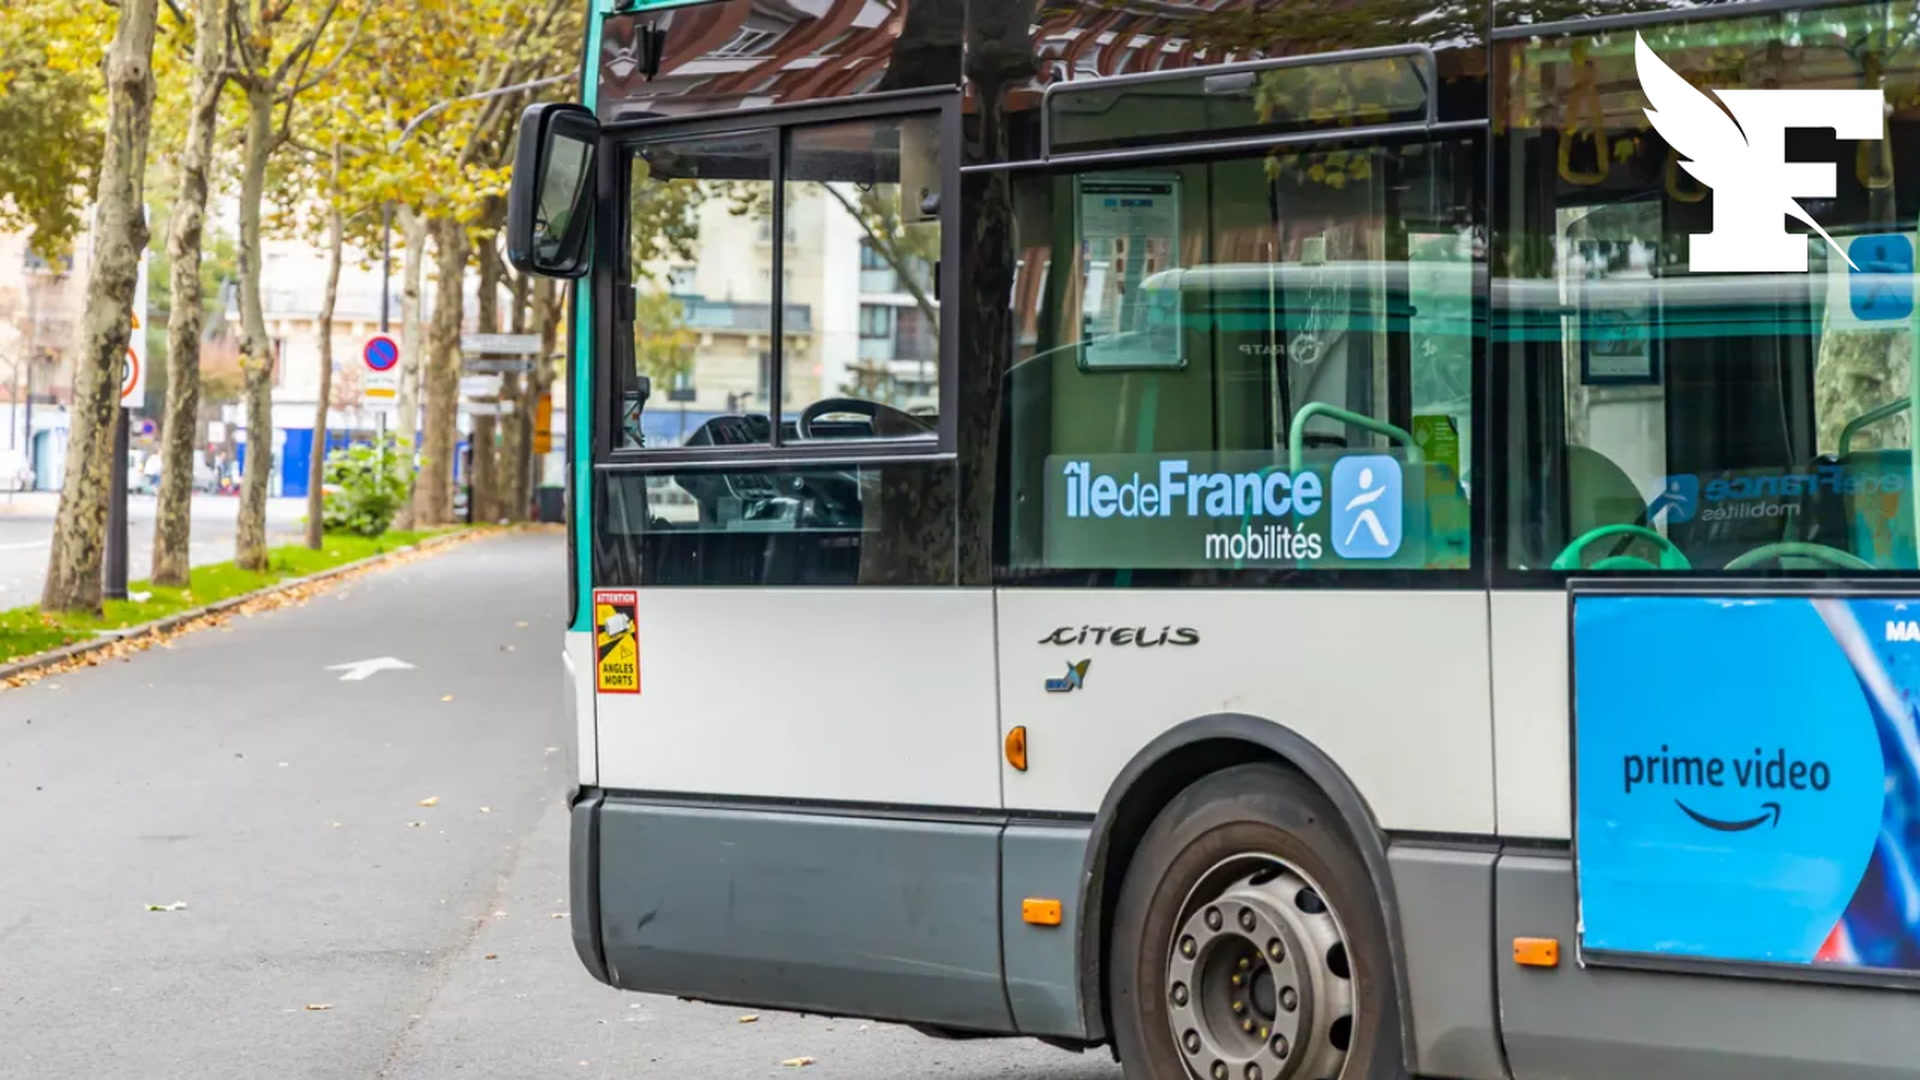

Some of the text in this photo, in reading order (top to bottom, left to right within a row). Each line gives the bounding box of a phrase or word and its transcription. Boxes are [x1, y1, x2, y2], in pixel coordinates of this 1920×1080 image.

[1205, 523, 1322, 560] mobilités
[603, 663, 634, 674] ANGLES
[605, 675, 633, 686] MORTS
[1624, 744, 1831, 794] prime video
